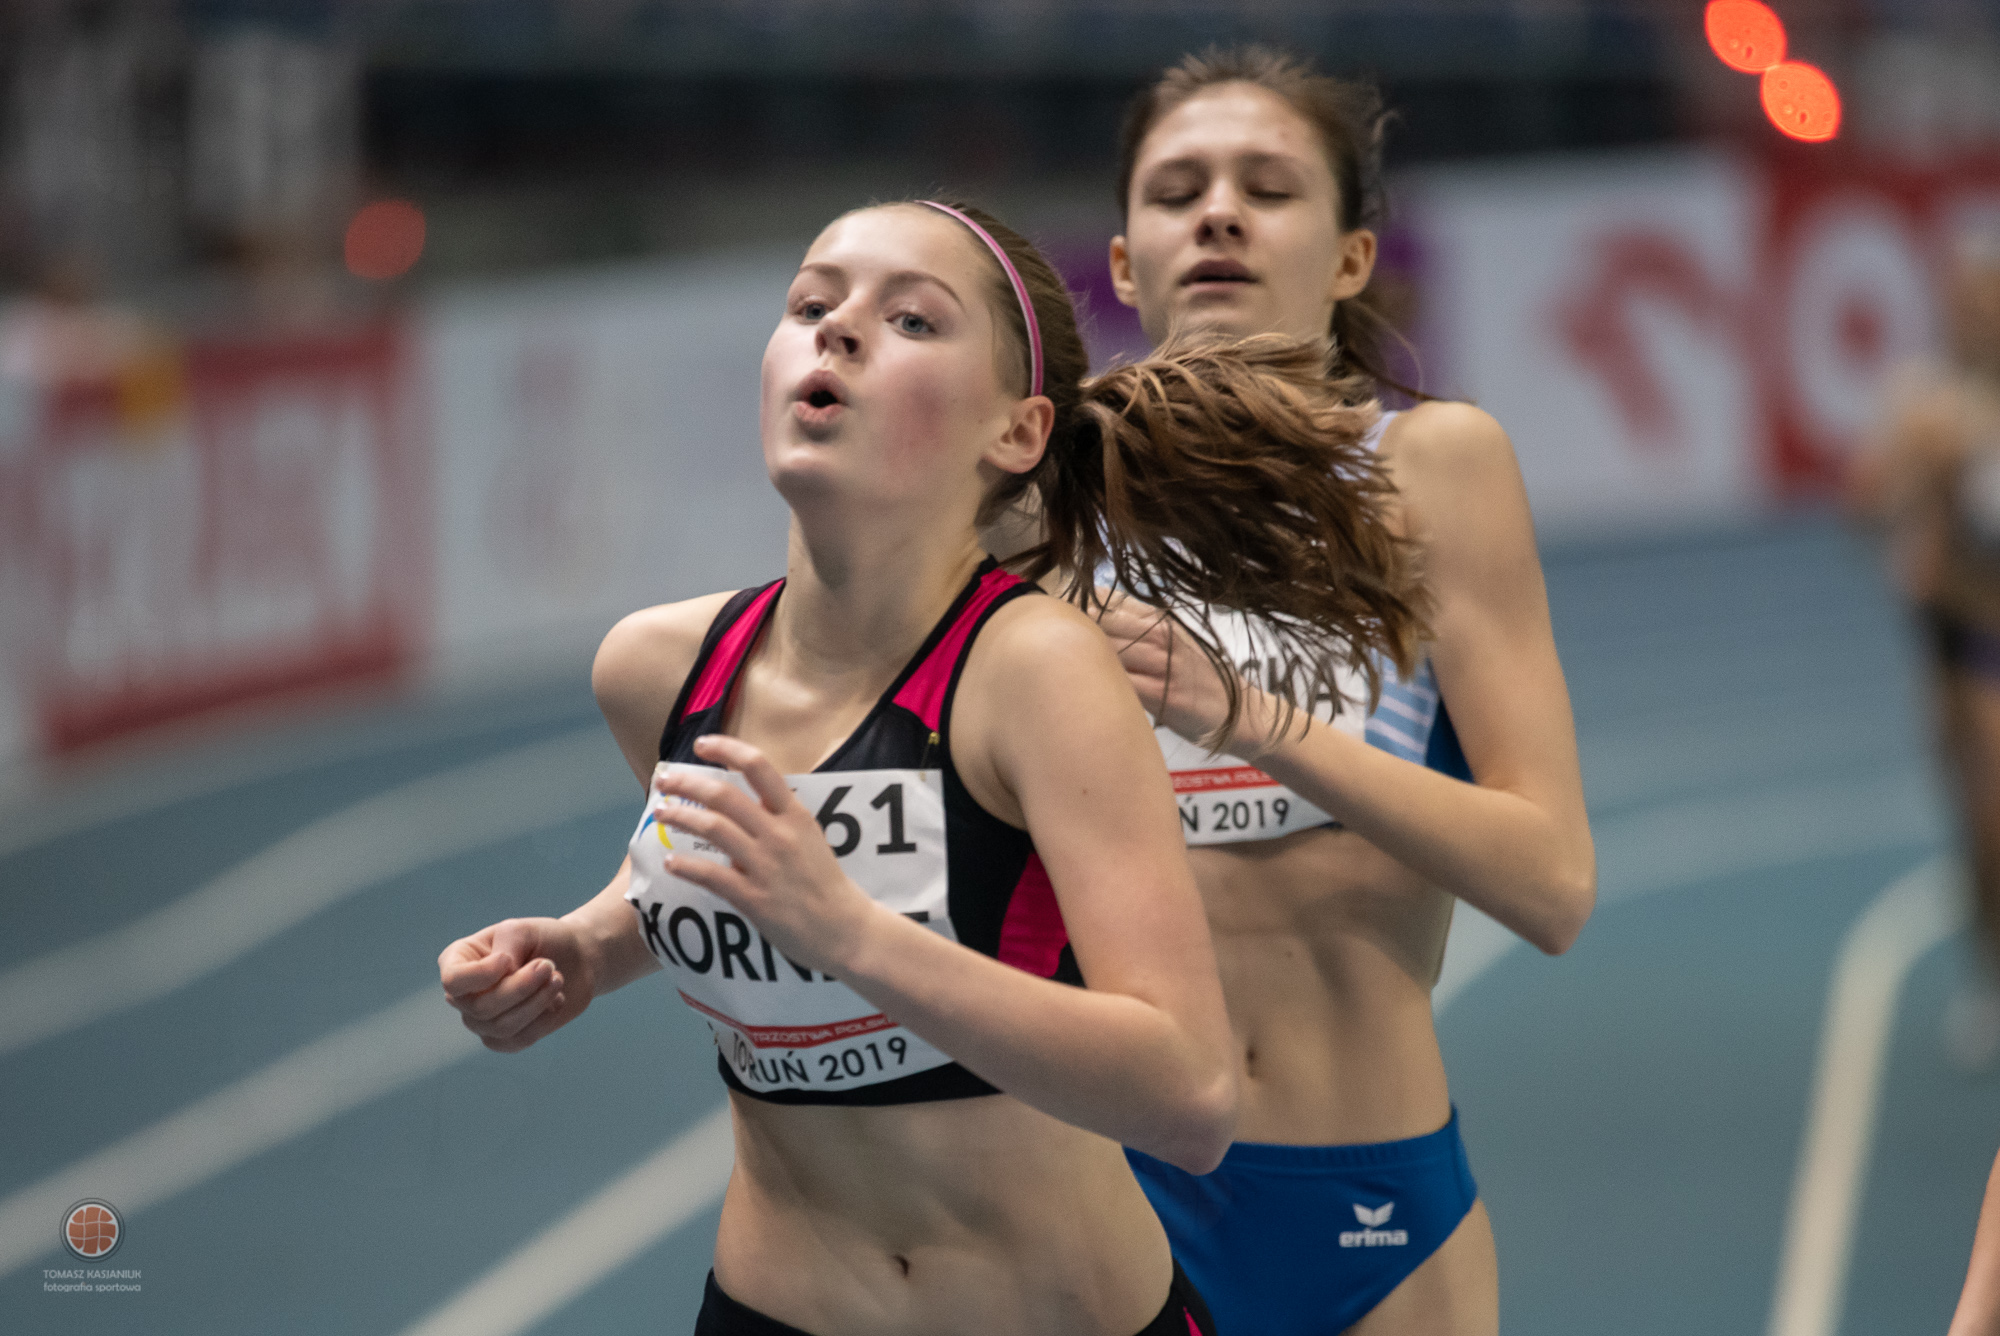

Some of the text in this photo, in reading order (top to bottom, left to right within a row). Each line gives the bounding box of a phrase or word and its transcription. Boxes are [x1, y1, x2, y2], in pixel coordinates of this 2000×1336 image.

[792, 783, 917, 858] 61
[1213, 798, 1290, 832] 2019
[818, 1036, 908, 1082] 2019
[1339, 1227, 1409, 1248] erima
